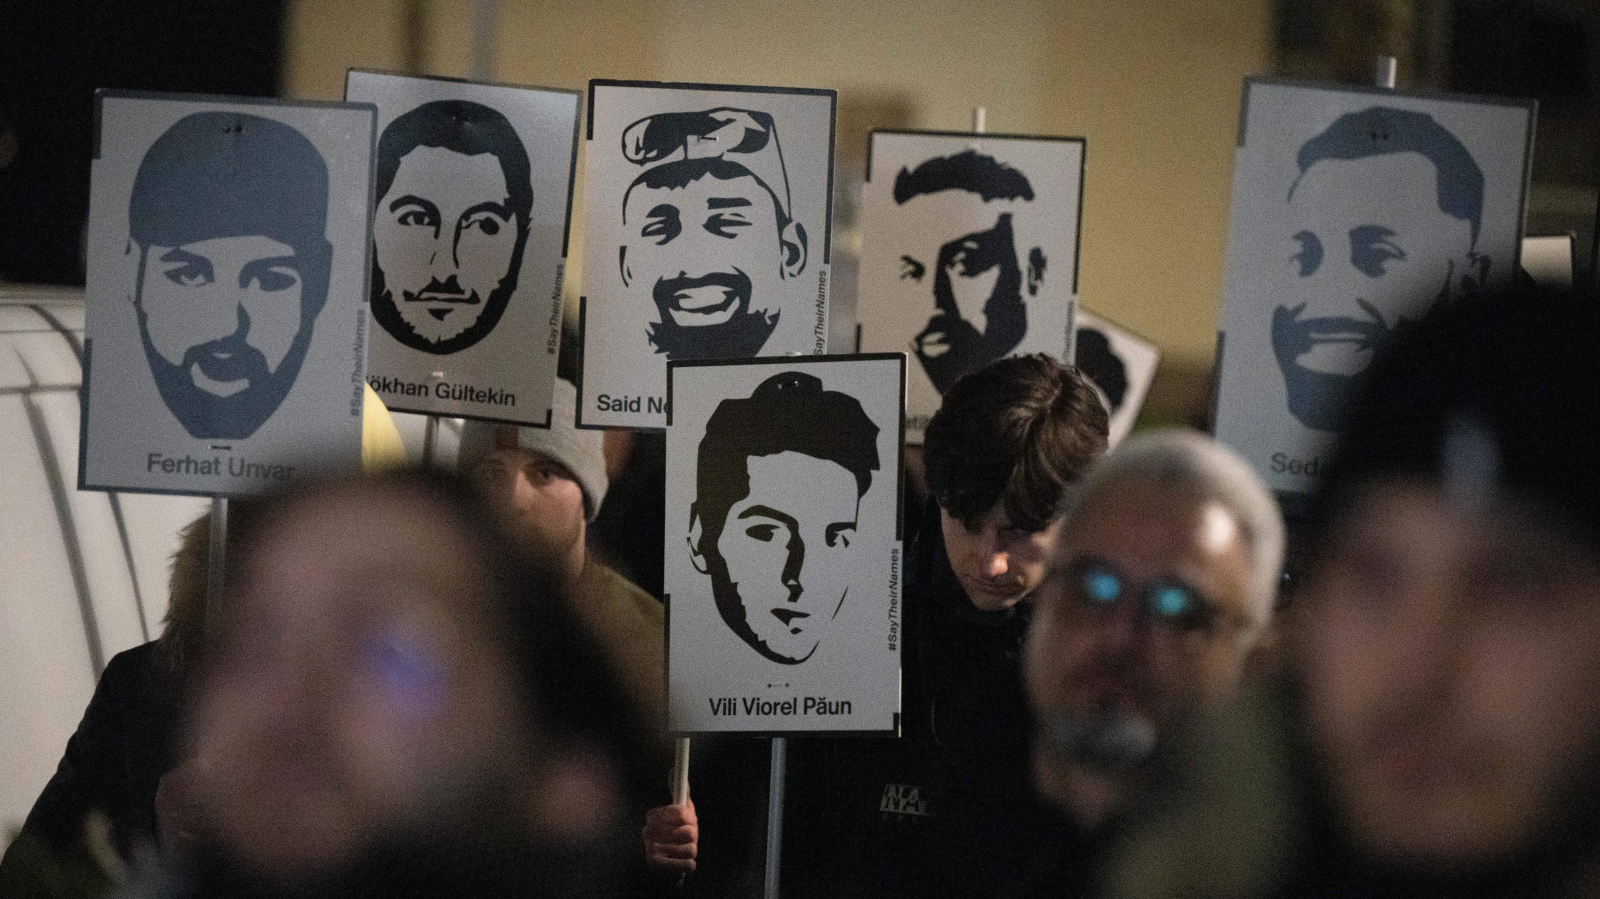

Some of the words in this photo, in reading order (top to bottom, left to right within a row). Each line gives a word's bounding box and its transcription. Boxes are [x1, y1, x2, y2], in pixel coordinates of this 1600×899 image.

[813, 270, 827, 355] SayTheirNames
[366, 376, 429, 397] ökhan
[435, 382, 516, 406] Gültekin
[597, 394, 641, 412] Said
[147, 452, 221, 475] Ferhat
[1270, 451, 1320, 476] Sed
[888, 548, 899, 652] #SayTheirNames
[708, 697, 737, 716] Vili
[742, 697, 798, 716] Viorel
[803, 696, 852, 715] Păun
